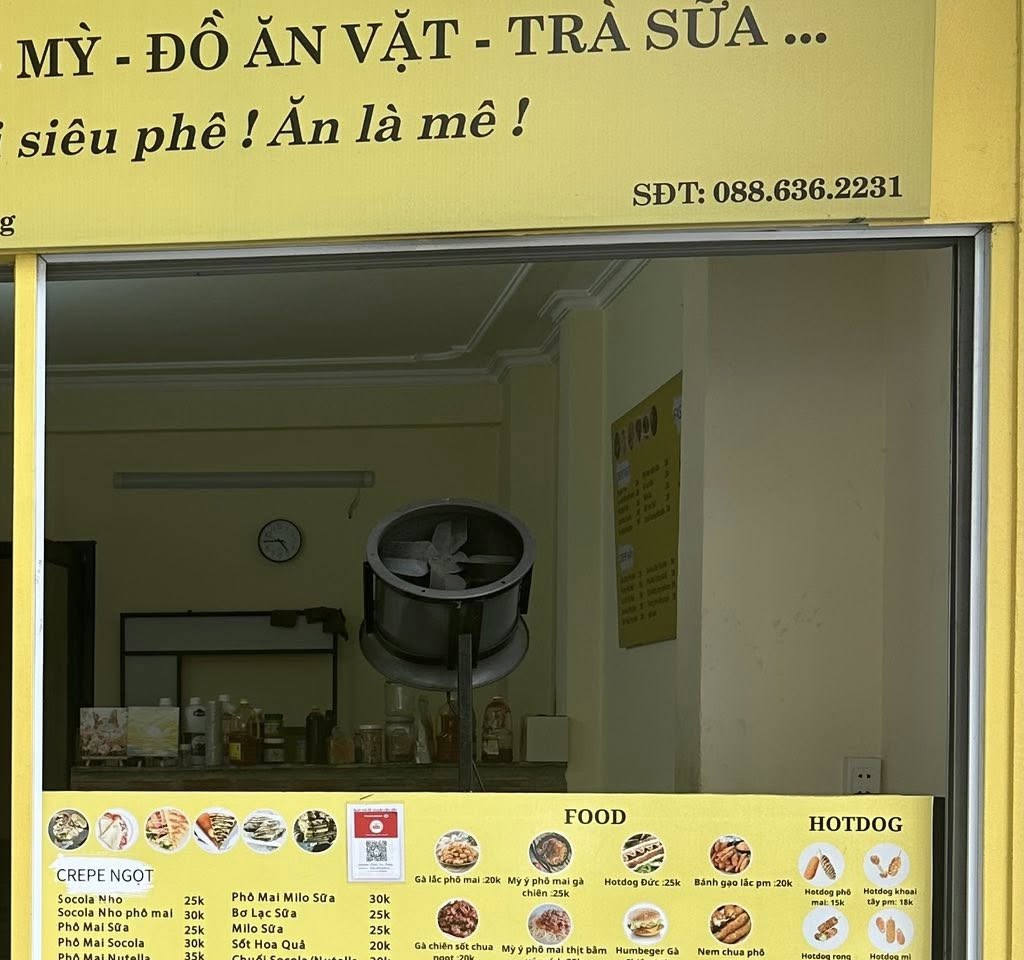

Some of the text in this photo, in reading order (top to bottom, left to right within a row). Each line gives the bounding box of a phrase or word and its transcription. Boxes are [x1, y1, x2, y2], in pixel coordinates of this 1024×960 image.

[16, 21, 102, 79] MỲ
[145, 8, 229, 73] ĐỒ
[243, 14, 327, 69] ĂN
[340, 8, 459, 74] VẶT
[507, 0, 631, 56] TRÀ
[645, 0, 769, 51] SỮA
[17, 118, 118, 159] siêu
[130, 111, 227, 163] phê
[266, 94, 340, 147] Ăn
[355, 103, 403, 143] là
[416, 99, 496, 141] mê
[632, 175, 903, 207] SĐT: 088.636.2231
[564, 808, 627, 825] FOOD
[808, 815, 904, 833] HOTDOG
[56, 868, 155, 886] CREPE NGỌT
[57, 893, 95, 905] Socola
[184, 895, 205, 906] 25k
[231, 891, 336, 903] Phô Mai Milo Sữa
[369, 893, 391, 905] 30k
[57, 907, 173, 920] Socola Nho phô mai
[184, 909, 205, 921] 30k
[231, 907, 297, 920] Bơ Lạc Sữa
[369, 909, 391, 920] 25k
[57, 921, 130, 933] Phô Mai Sữa
[184, 924, 205, 936] 25k
[231, 922, 284, 934] Milo Sữa
[369, 924, 391, 936] 25k
[57, 936, 145, 948] Phô Mai Socola
[184, 938, 205, 949] 30k
[231, 937, 251, 950] Sốt
[254, 939, 278, 950] Hoa
[369, 940, 391, 951] 20k
